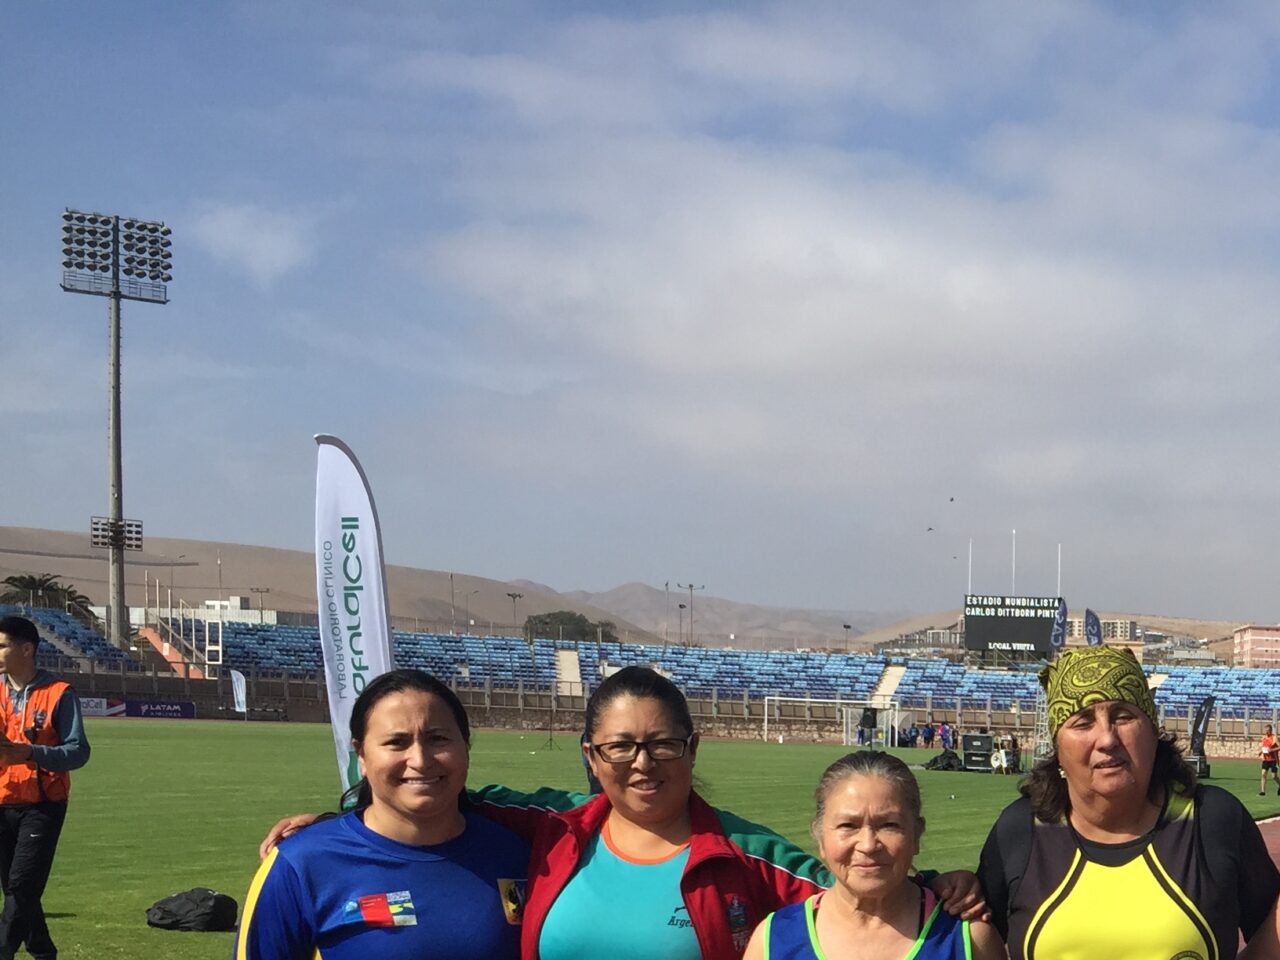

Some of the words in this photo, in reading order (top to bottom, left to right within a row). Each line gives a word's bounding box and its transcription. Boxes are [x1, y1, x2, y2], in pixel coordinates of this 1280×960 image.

[966, 596, 1002, 606] ESTADIO
[1005, 597, 1059, 607] MUNDIALISTA
[965, 607, 996, 616] CARLOS
[997, 608, 1035, 617] DITTBORN
[988, 642, 1011, 650] LOCAL
